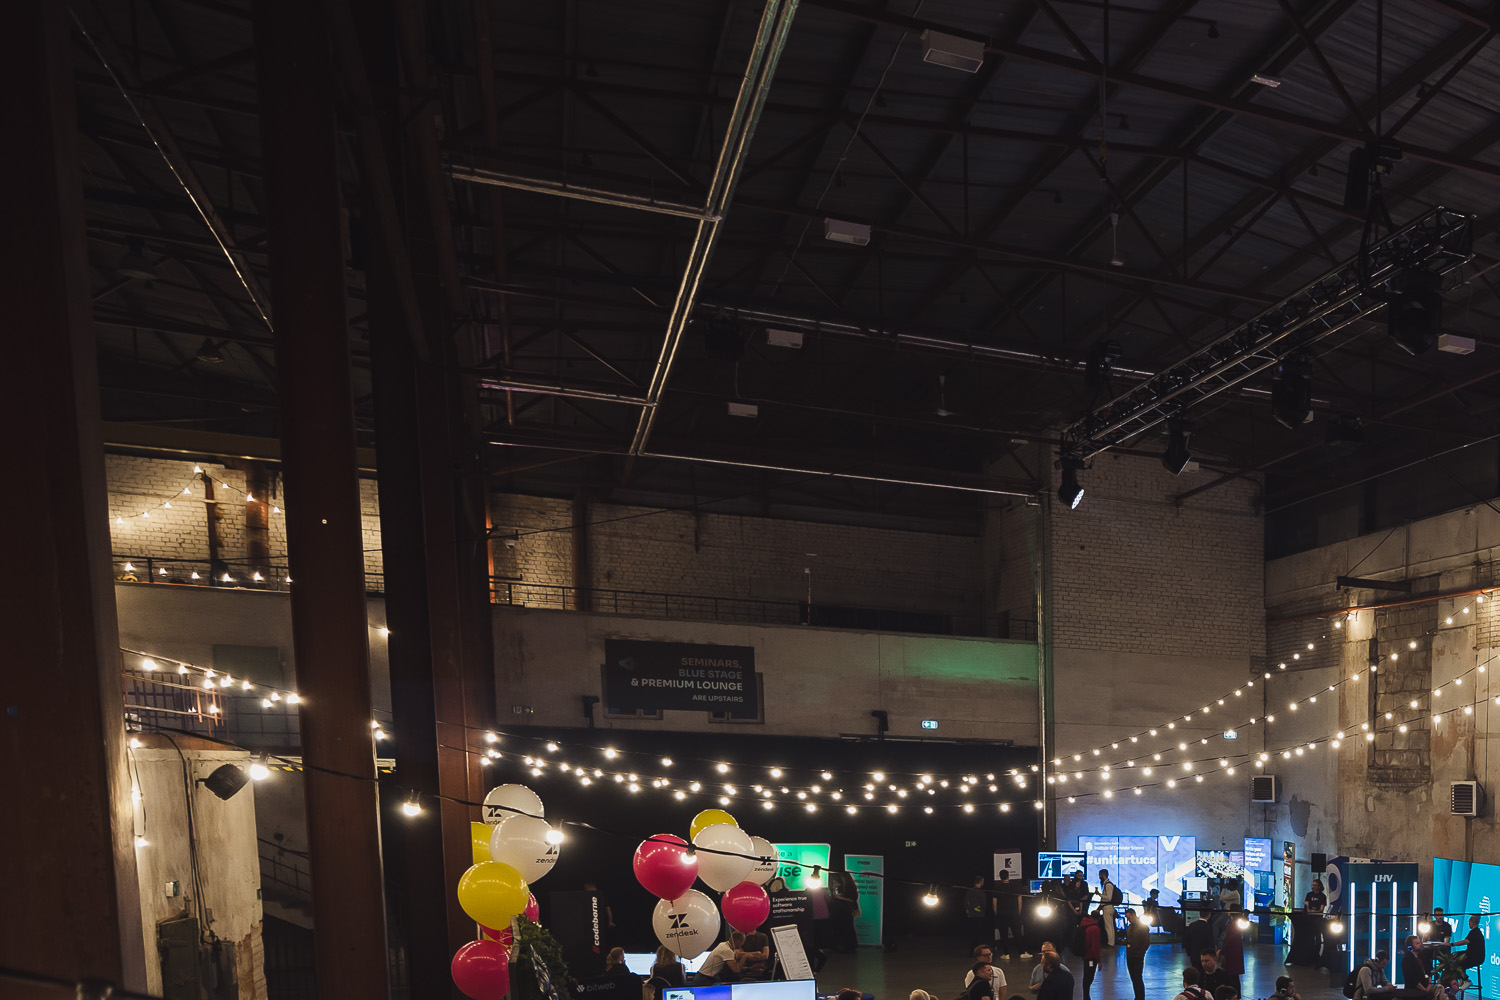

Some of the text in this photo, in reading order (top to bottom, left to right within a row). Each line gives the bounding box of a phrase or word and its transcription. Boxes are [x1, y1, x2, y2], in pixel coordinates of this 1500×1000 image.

[681, 657, 742, 669] SEMINARS,
[679, 669, 743, 679] BLUE STAGE
[630, 678, 743, 691] & PREMIUM LOUNGE
[708, 695, 743, 703] UPSTAIRS
[1087, 854, 1157, 865] #unitartucs
[778, 866, 802, 877] ise
[1374, 874, 1393, 883] LHV
[665, 929, 699, 939] zendesk
[586, 981, 616, 992] bitweb
